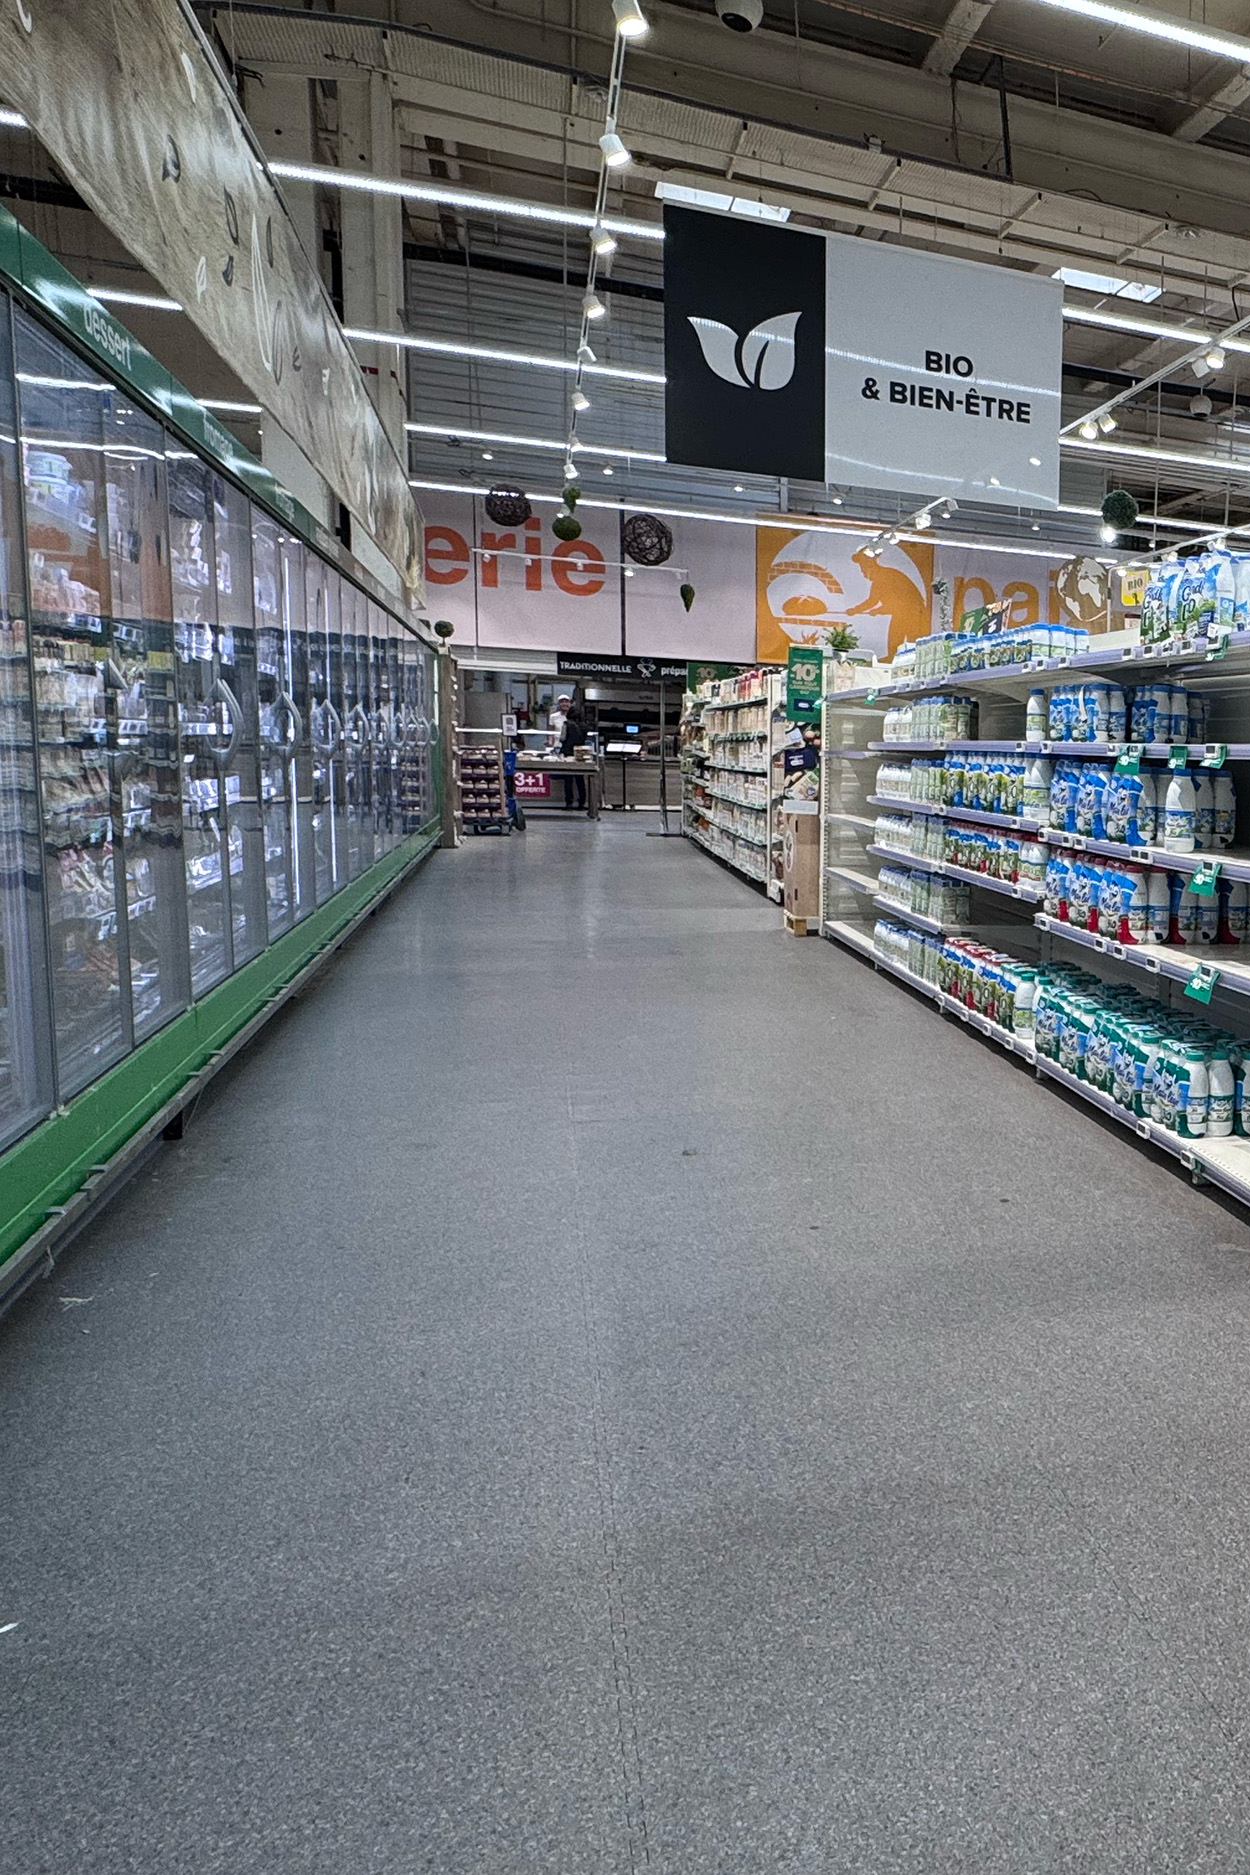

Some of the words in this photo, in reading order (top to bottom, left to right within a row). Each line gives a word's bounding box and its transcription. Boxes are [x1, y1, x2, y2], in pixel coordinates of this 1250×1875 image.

[925, 350, 973, 377] BIO
[861, 377, 880, 401] &
[889, 381, 1031, 424] BIEN-ÊTRE
[425, 517, 606, 596] erie
[1127, 577, 1143, 591] BIO
[560, 661, 632, 673] TRADITIONNELLE
[514, 772, 544, 787] 3+1
[515, 786, 547, 794] OFFERTE
